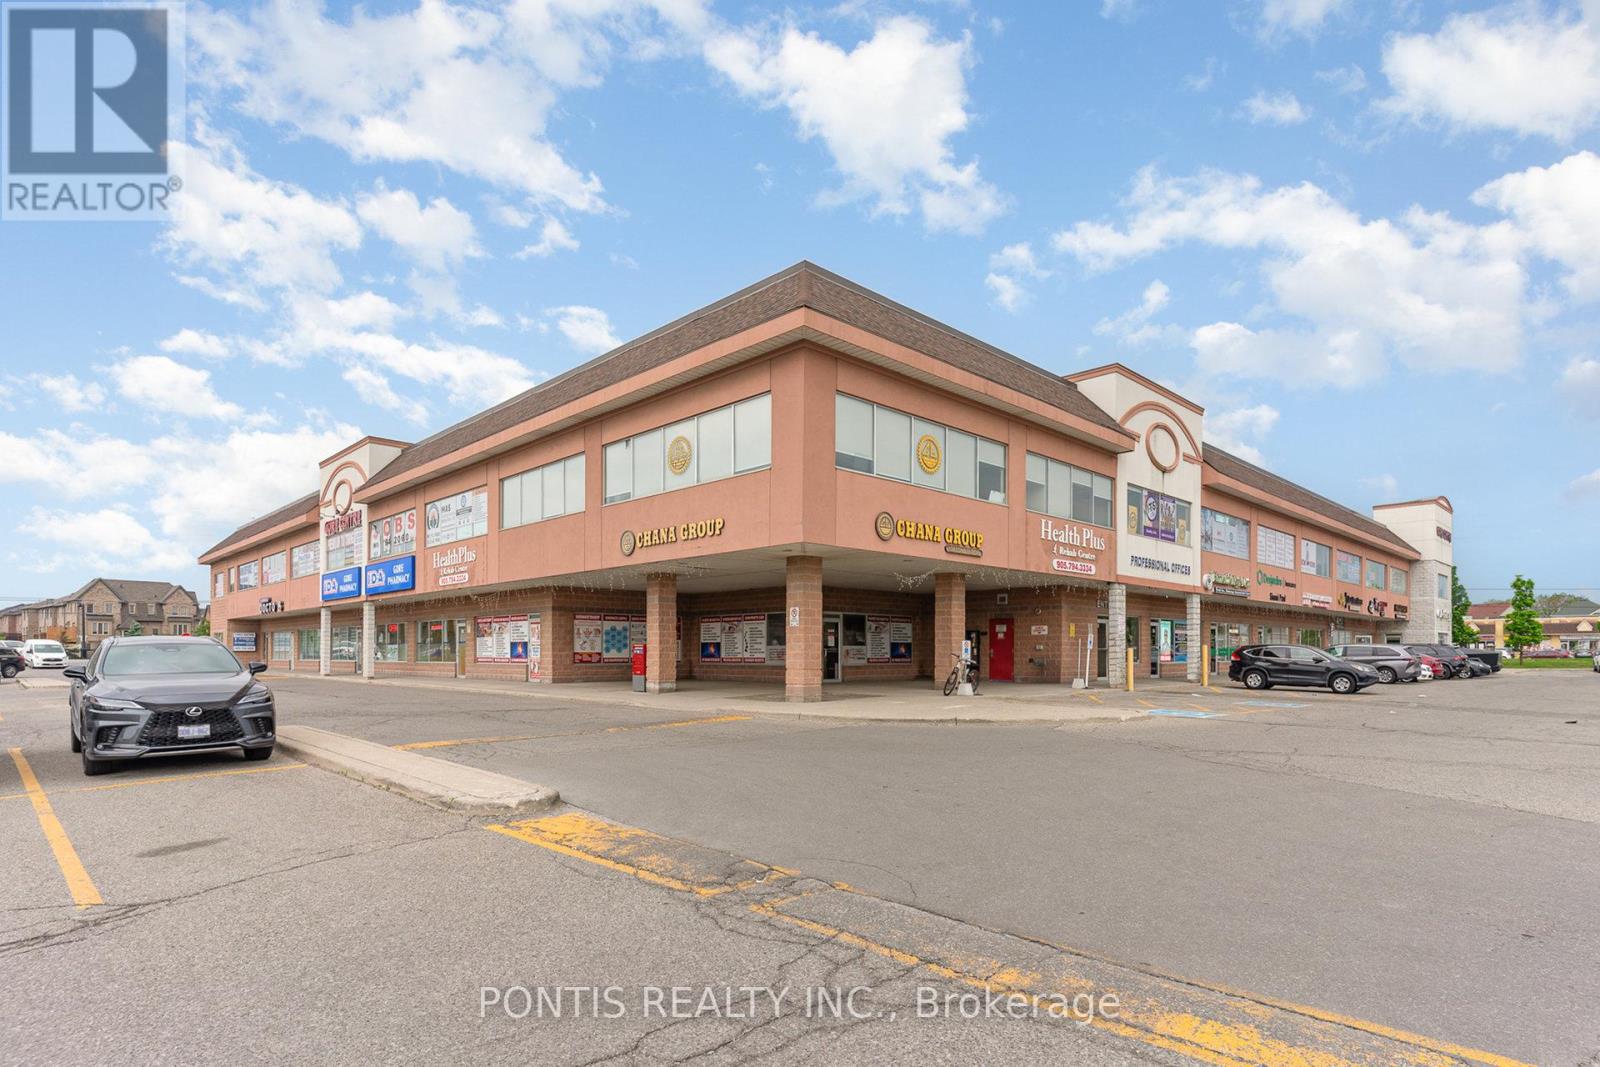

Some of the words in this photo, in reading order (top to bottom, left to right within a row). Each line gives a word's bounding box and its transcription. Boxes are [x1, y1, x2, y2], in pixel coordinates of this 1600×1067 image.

[636, 526, 677, 548] CHANA
[680, 517, 725, 541] GROUP
[896, 519, 941, 543] CHANA
[944, 527, 984, 548] GROUP
[1040, 518, 1080, 548] Health
[1082, 527, 1105, 551] Plus
[433, 548, 459, 569] Health
[459, 545, 477, 565] Plus
[1130, 555, 1170, 572] PROFESSIONAL
[1171, 563, 1191, 576] OFFICES
